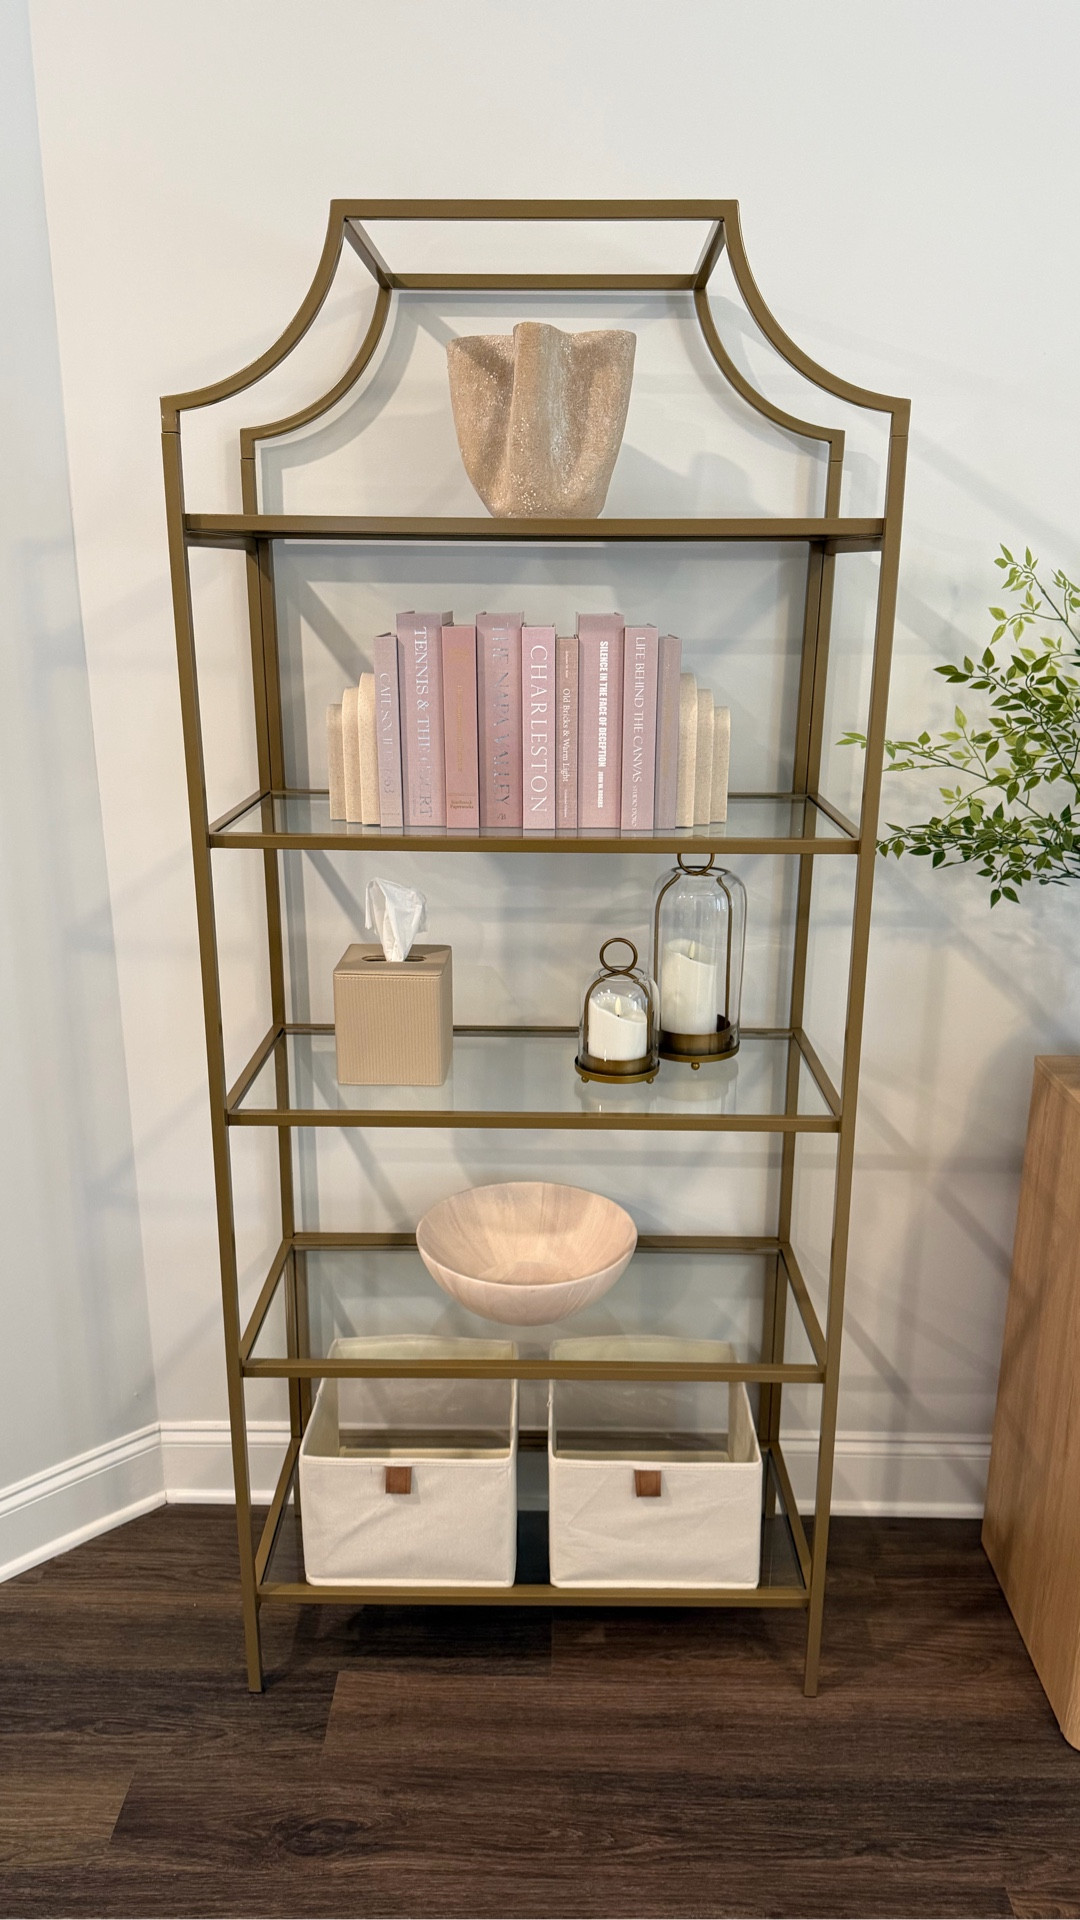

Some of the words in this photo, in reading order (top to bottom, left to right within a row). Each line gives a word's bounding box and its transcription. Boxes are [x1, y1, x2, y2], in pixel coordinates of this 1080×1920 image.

[600, 641, 608, 671] SILENCE
[635, 637, 646, 660] LIFE
[414, 626, 429, 695] TENNIS
[600, 673, 608, 681] IN
[634, 663, 646, 708] BEHIND
[493, 671, 510, 726] NAPA
[563, 688, 571, 702] Old
[599, 682, 607, 696] THE
[416, 699, 430, 711] &
[562, 705, 571, 728] Bricks
[599, 698, 607, 715] FACE
[530, 645, 548, 812] CHARLESTON
[599, 717, 607, 726] OF
[633, 710, 644, 733] THE
[562, 739, 570, 761] Warm
[598, 727, 606, 767] DECEPTION
[493, 733, 511, 805] VALLEY
[632, 736, 644, 782] CANVAS
[560, 763, 570, 782] Light
[418, 756, 434, 818] CRT
